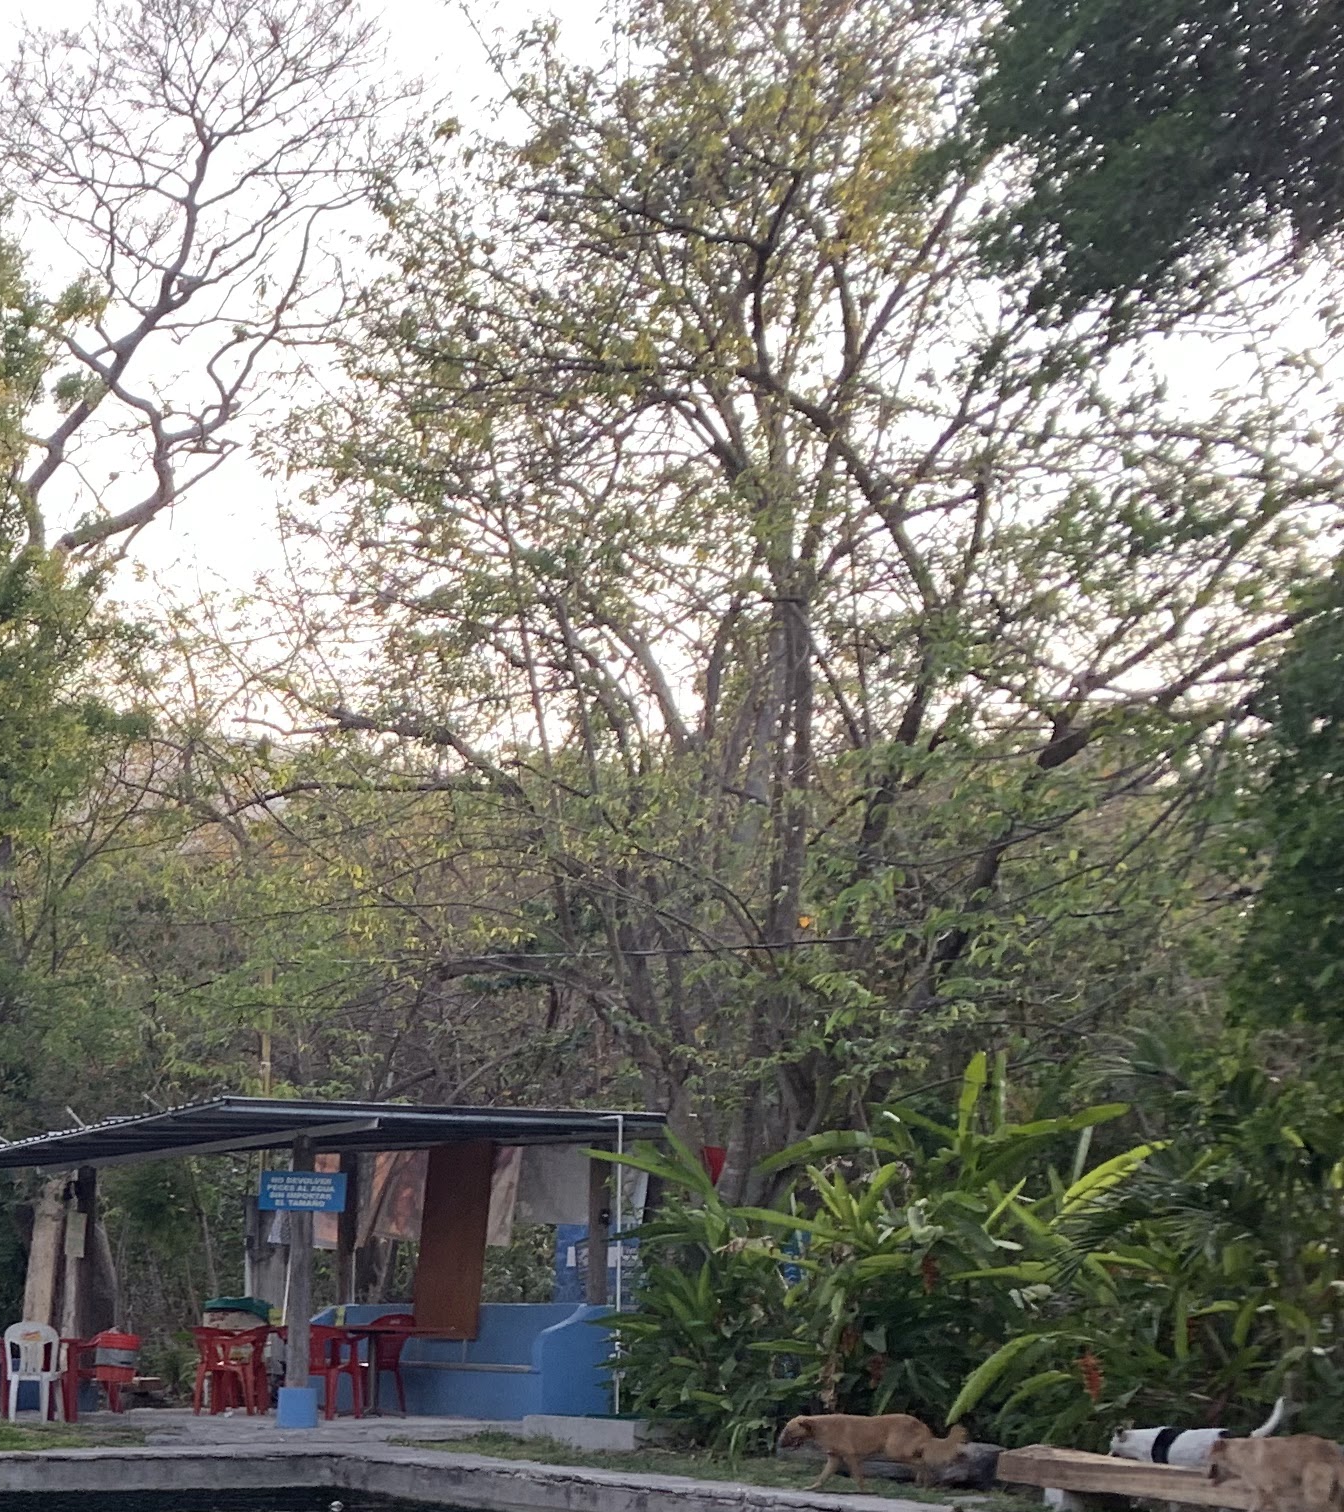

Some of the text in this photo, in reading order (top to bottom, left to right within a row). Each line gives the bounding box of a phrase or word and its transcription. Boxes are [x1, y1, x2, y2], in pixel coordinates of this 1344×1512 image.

[286, 1176, 333, 1185] DEVOLVER
[296, 1184, 309, 1192] AL
[310, 1185, 335, 1193] AGUA
[286, 1191, 332, 1200] IMPORTAR
[274, 1199, 285, 1207] EL
